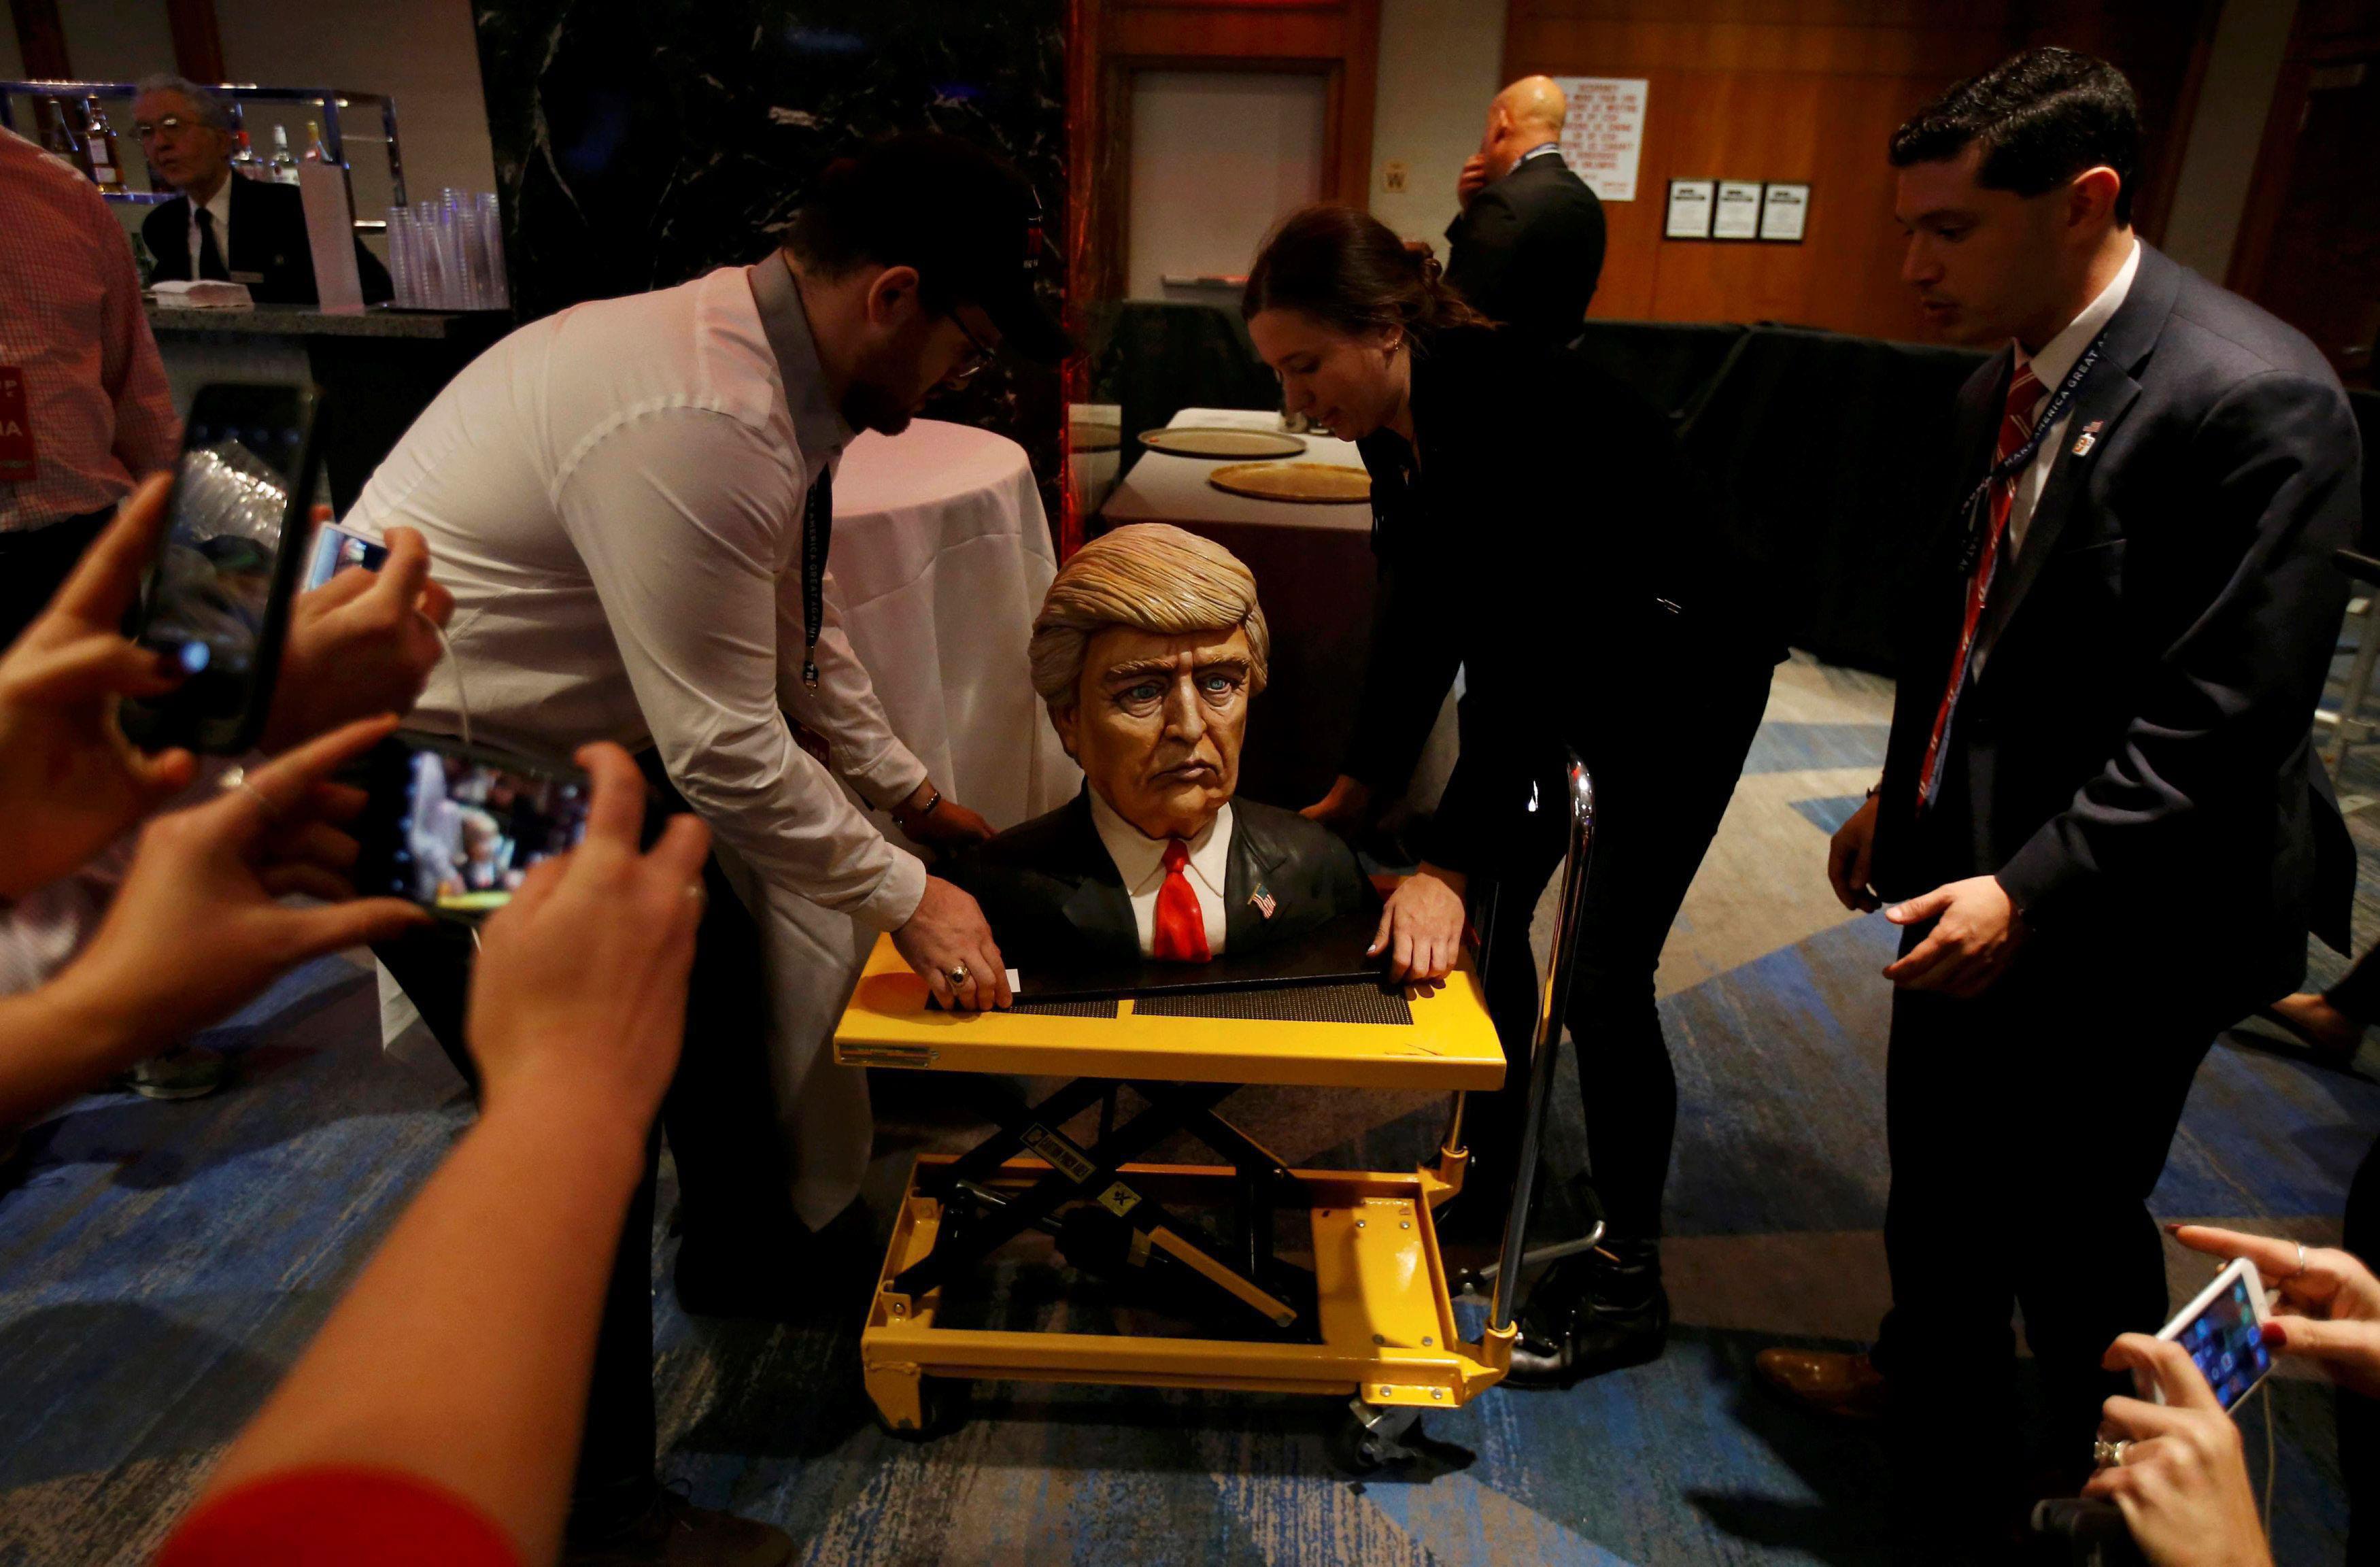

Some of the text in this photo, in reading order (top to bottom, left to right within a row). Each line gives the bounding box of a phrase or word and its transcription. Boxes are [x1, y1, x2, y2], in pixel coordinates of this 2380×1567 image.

[2034, 390, 2071, 439] AMERICA
[2067, 348, 2099, 388] GREAT
[808, 562, 819, 599] GREAT
